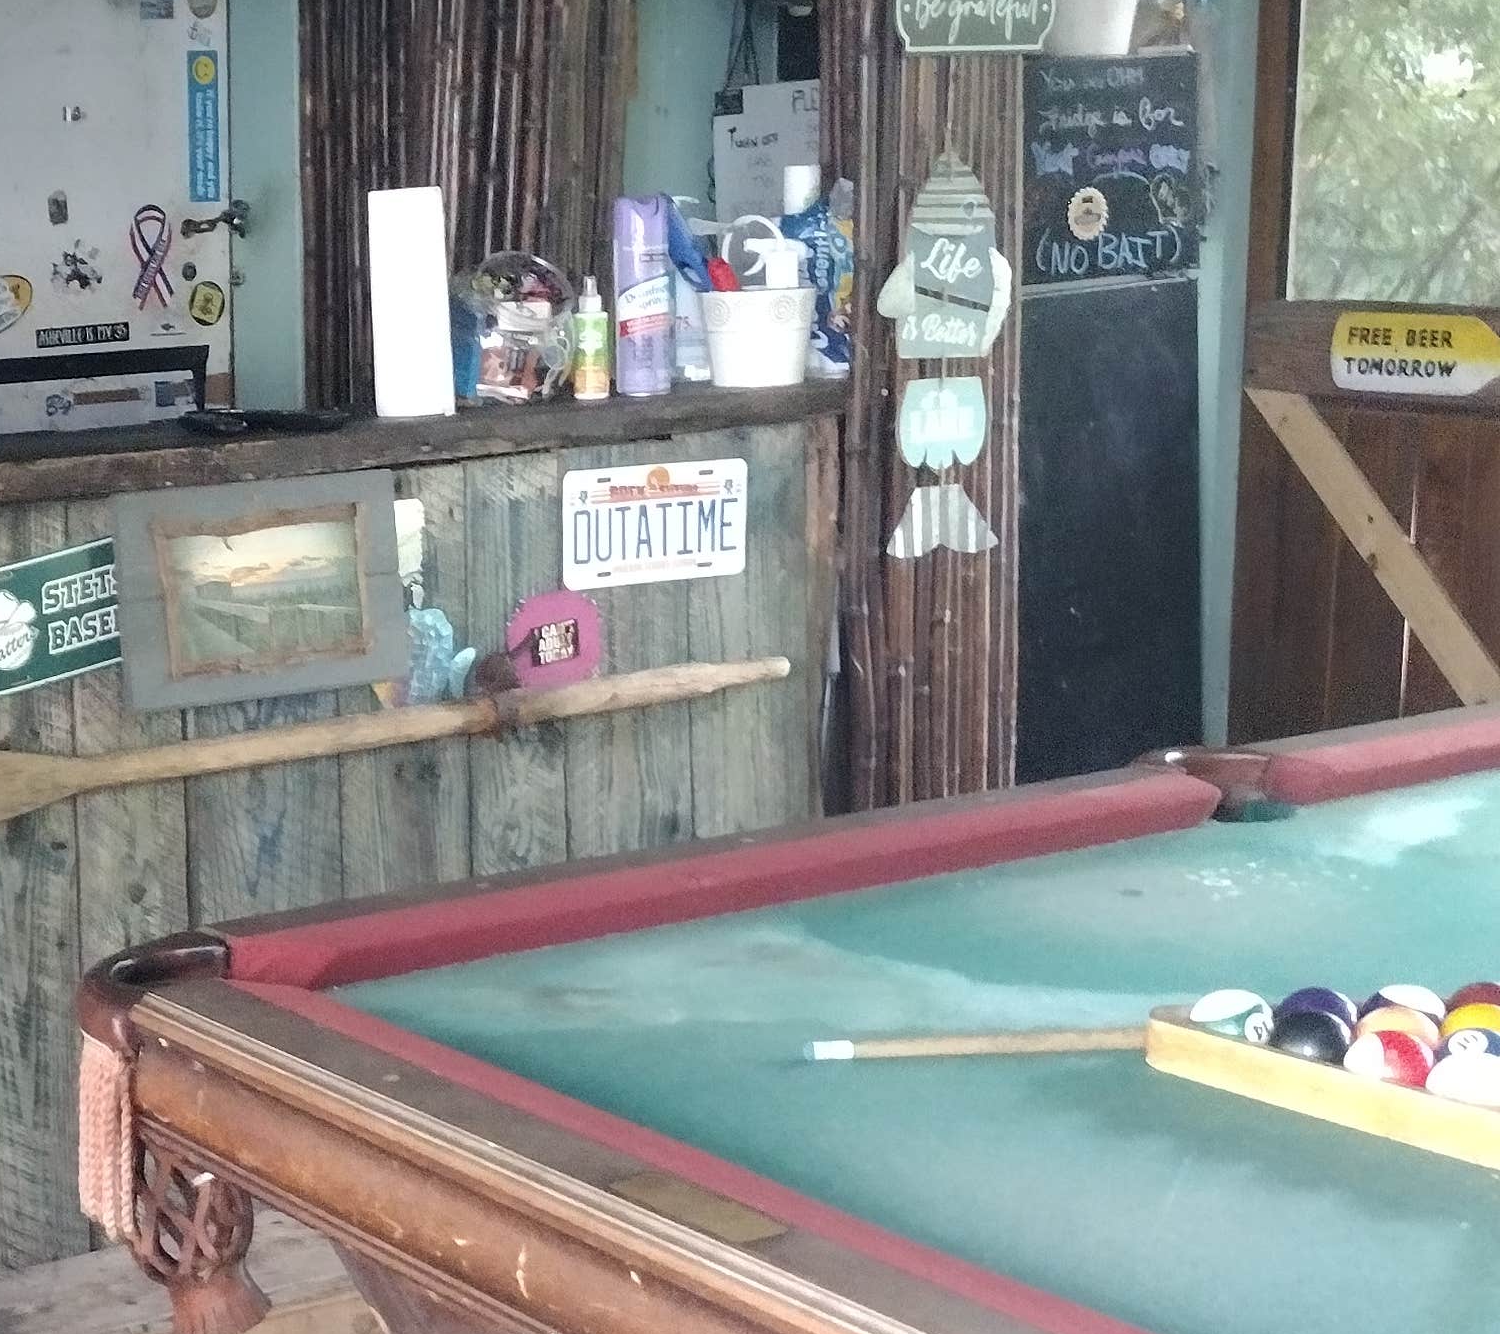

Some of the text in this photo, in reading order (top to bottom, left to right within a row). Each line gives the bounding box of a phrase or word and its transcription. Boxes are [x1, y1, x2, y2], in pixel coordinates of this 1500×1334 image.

[920, 237, 984, 284] Life
[1347, 326, 1454, 349] FREE BEER
[1343, 356, 1458, 378] TOMORROW
[572, 497, 739, 565] OUTATIME
[41, 564, 118, 615] STET
[47, 605, 121, 656] BASE
